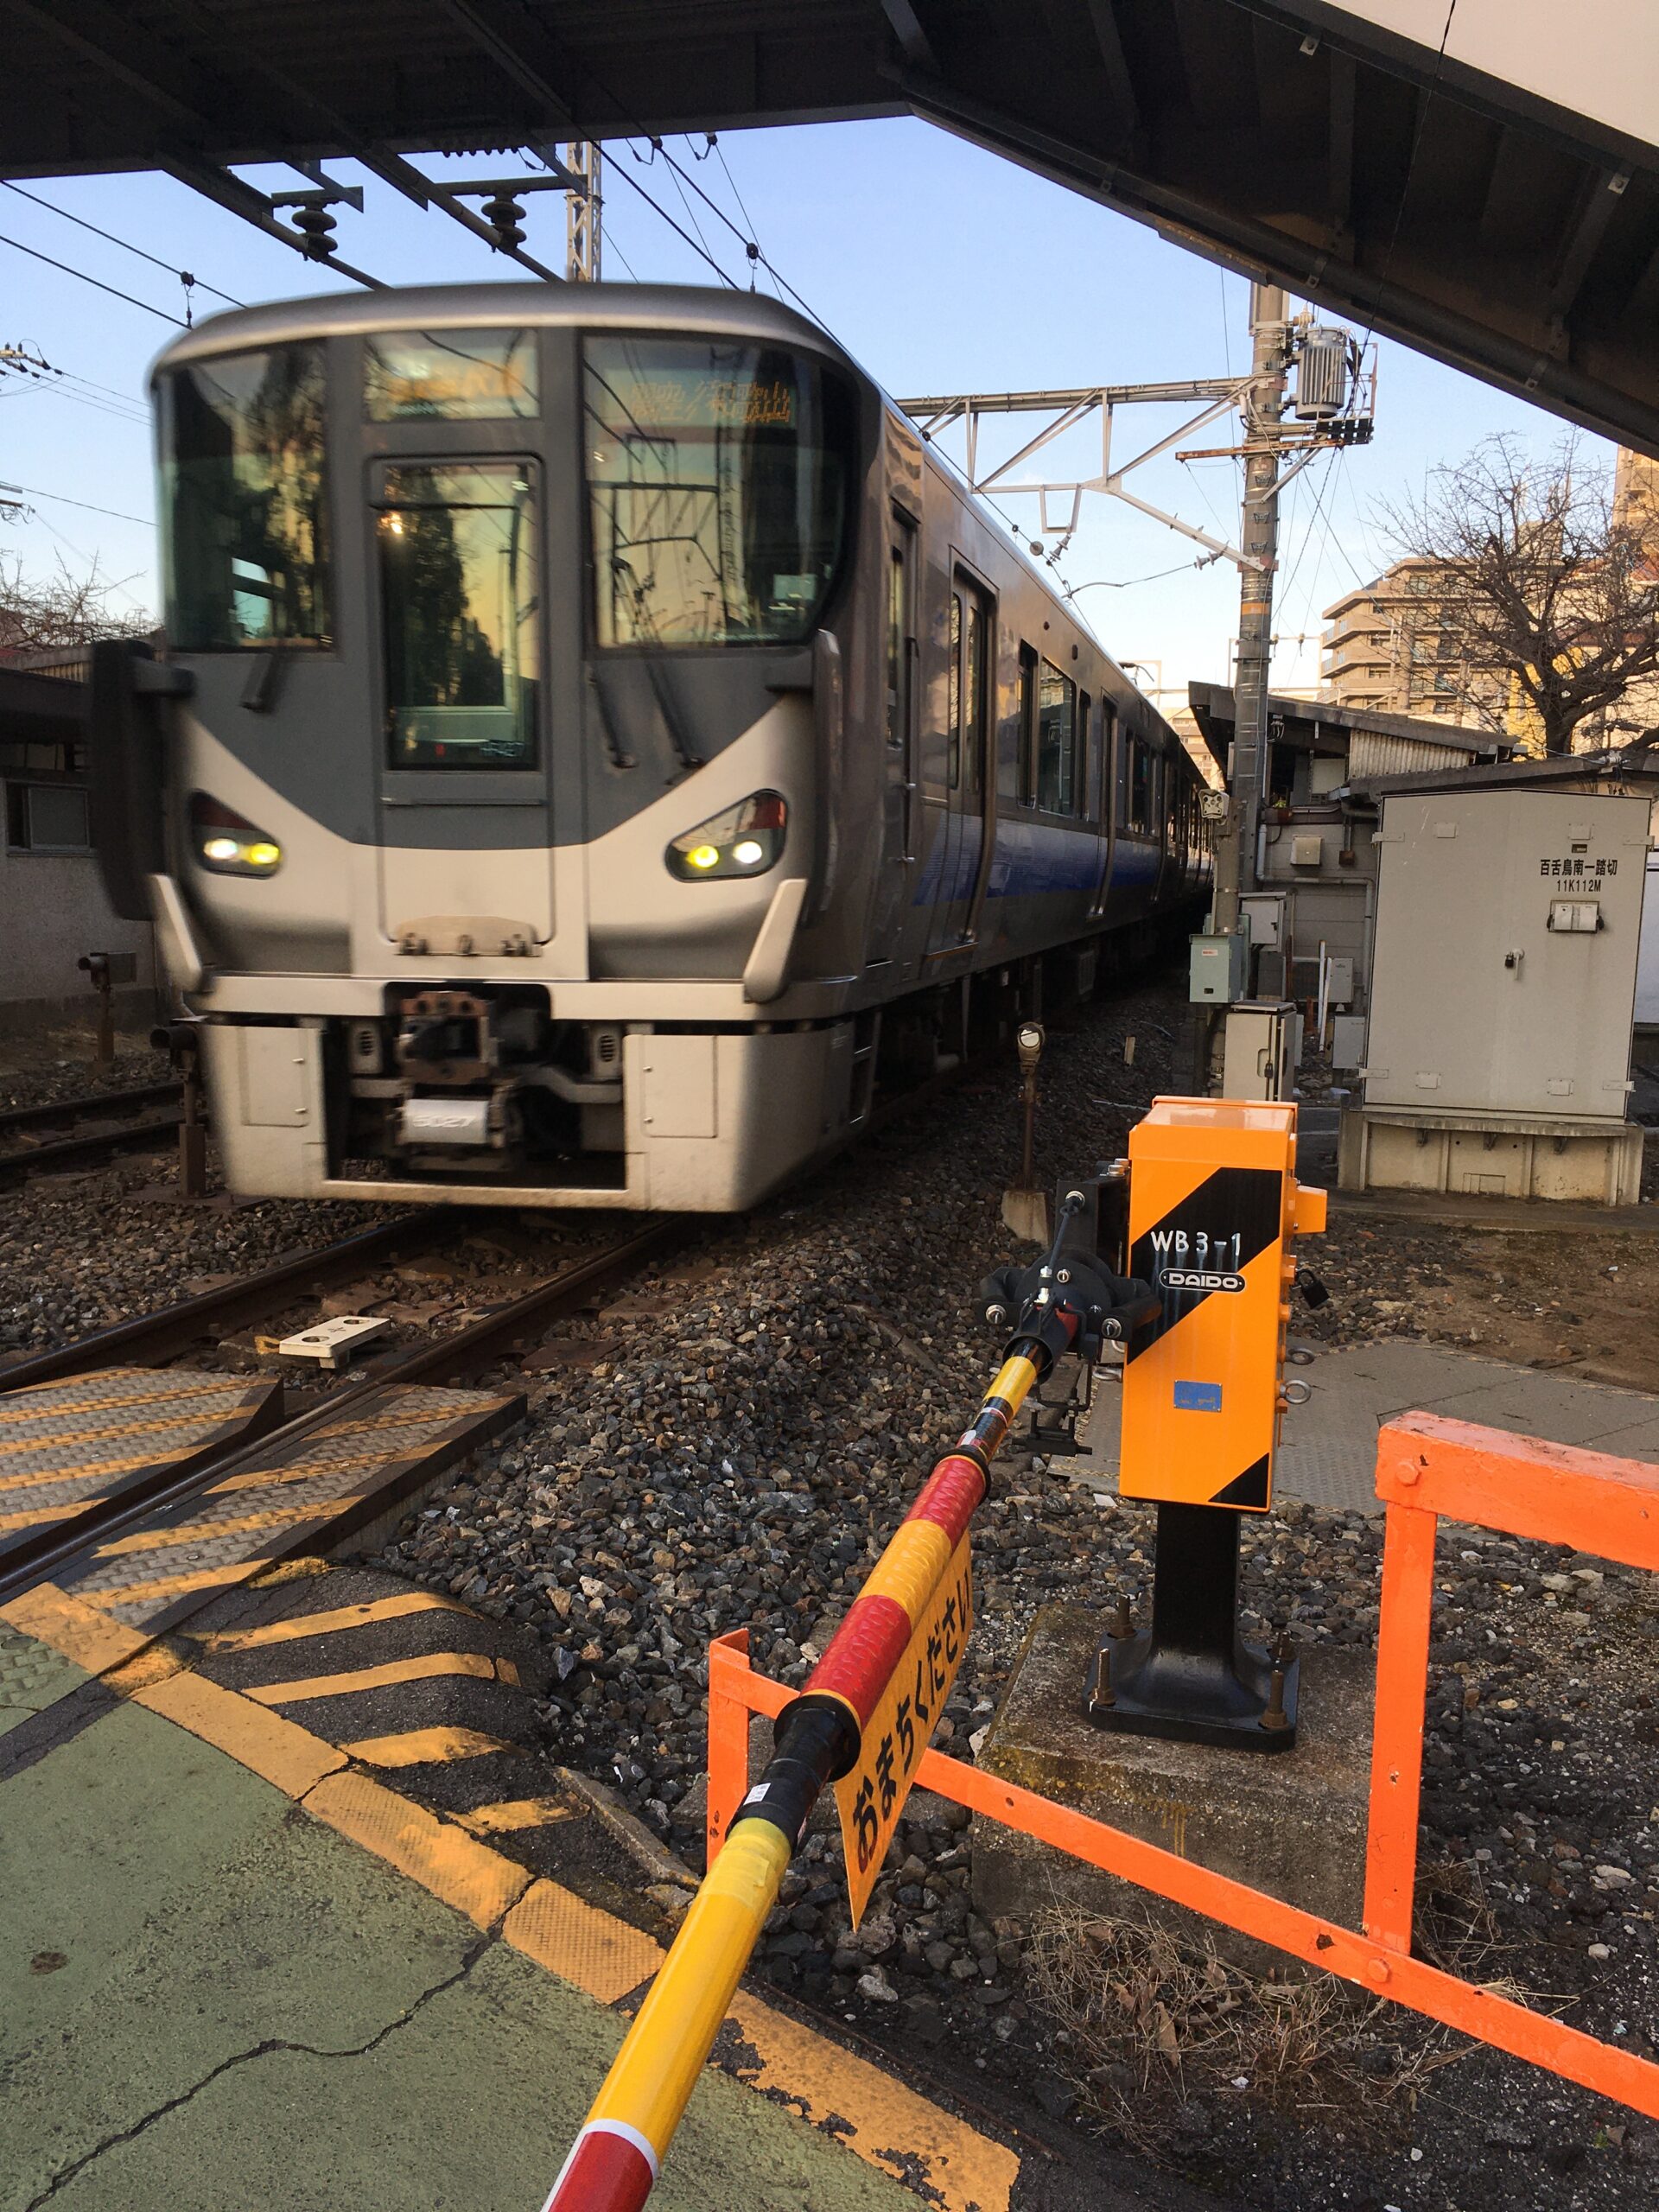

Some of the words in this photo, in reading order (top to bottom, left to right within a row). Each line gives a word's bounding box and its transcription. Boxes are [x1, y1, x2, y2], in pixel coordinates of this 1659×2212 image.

[1540, 859, 1618, 876] 百舌鳥南一踏切
[1557, 880, 1601, 892] 11K112M
[1168, 1273, 1238, 1289] DAIDO
[853, 1568, 969, 1873] おまちください
